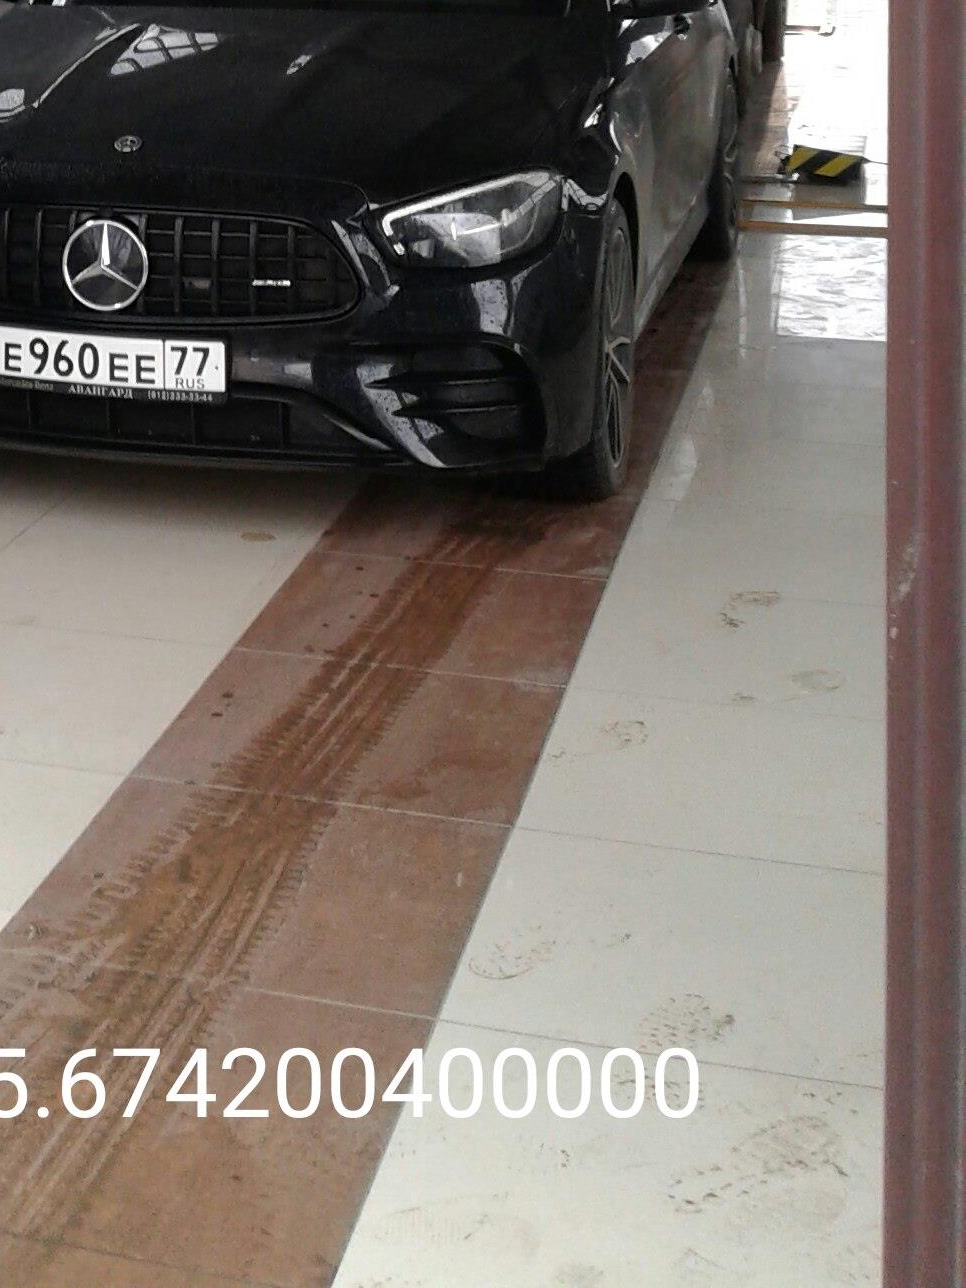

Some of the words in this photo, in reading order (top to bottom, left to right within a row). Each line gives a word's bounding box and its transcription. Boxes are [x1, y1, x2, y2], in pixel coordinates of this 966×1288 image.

[170, 346, 210, 376] 77
[175, 379, 205, 390] RUS
[68, 385, 133, 400] АВАНГАРД
